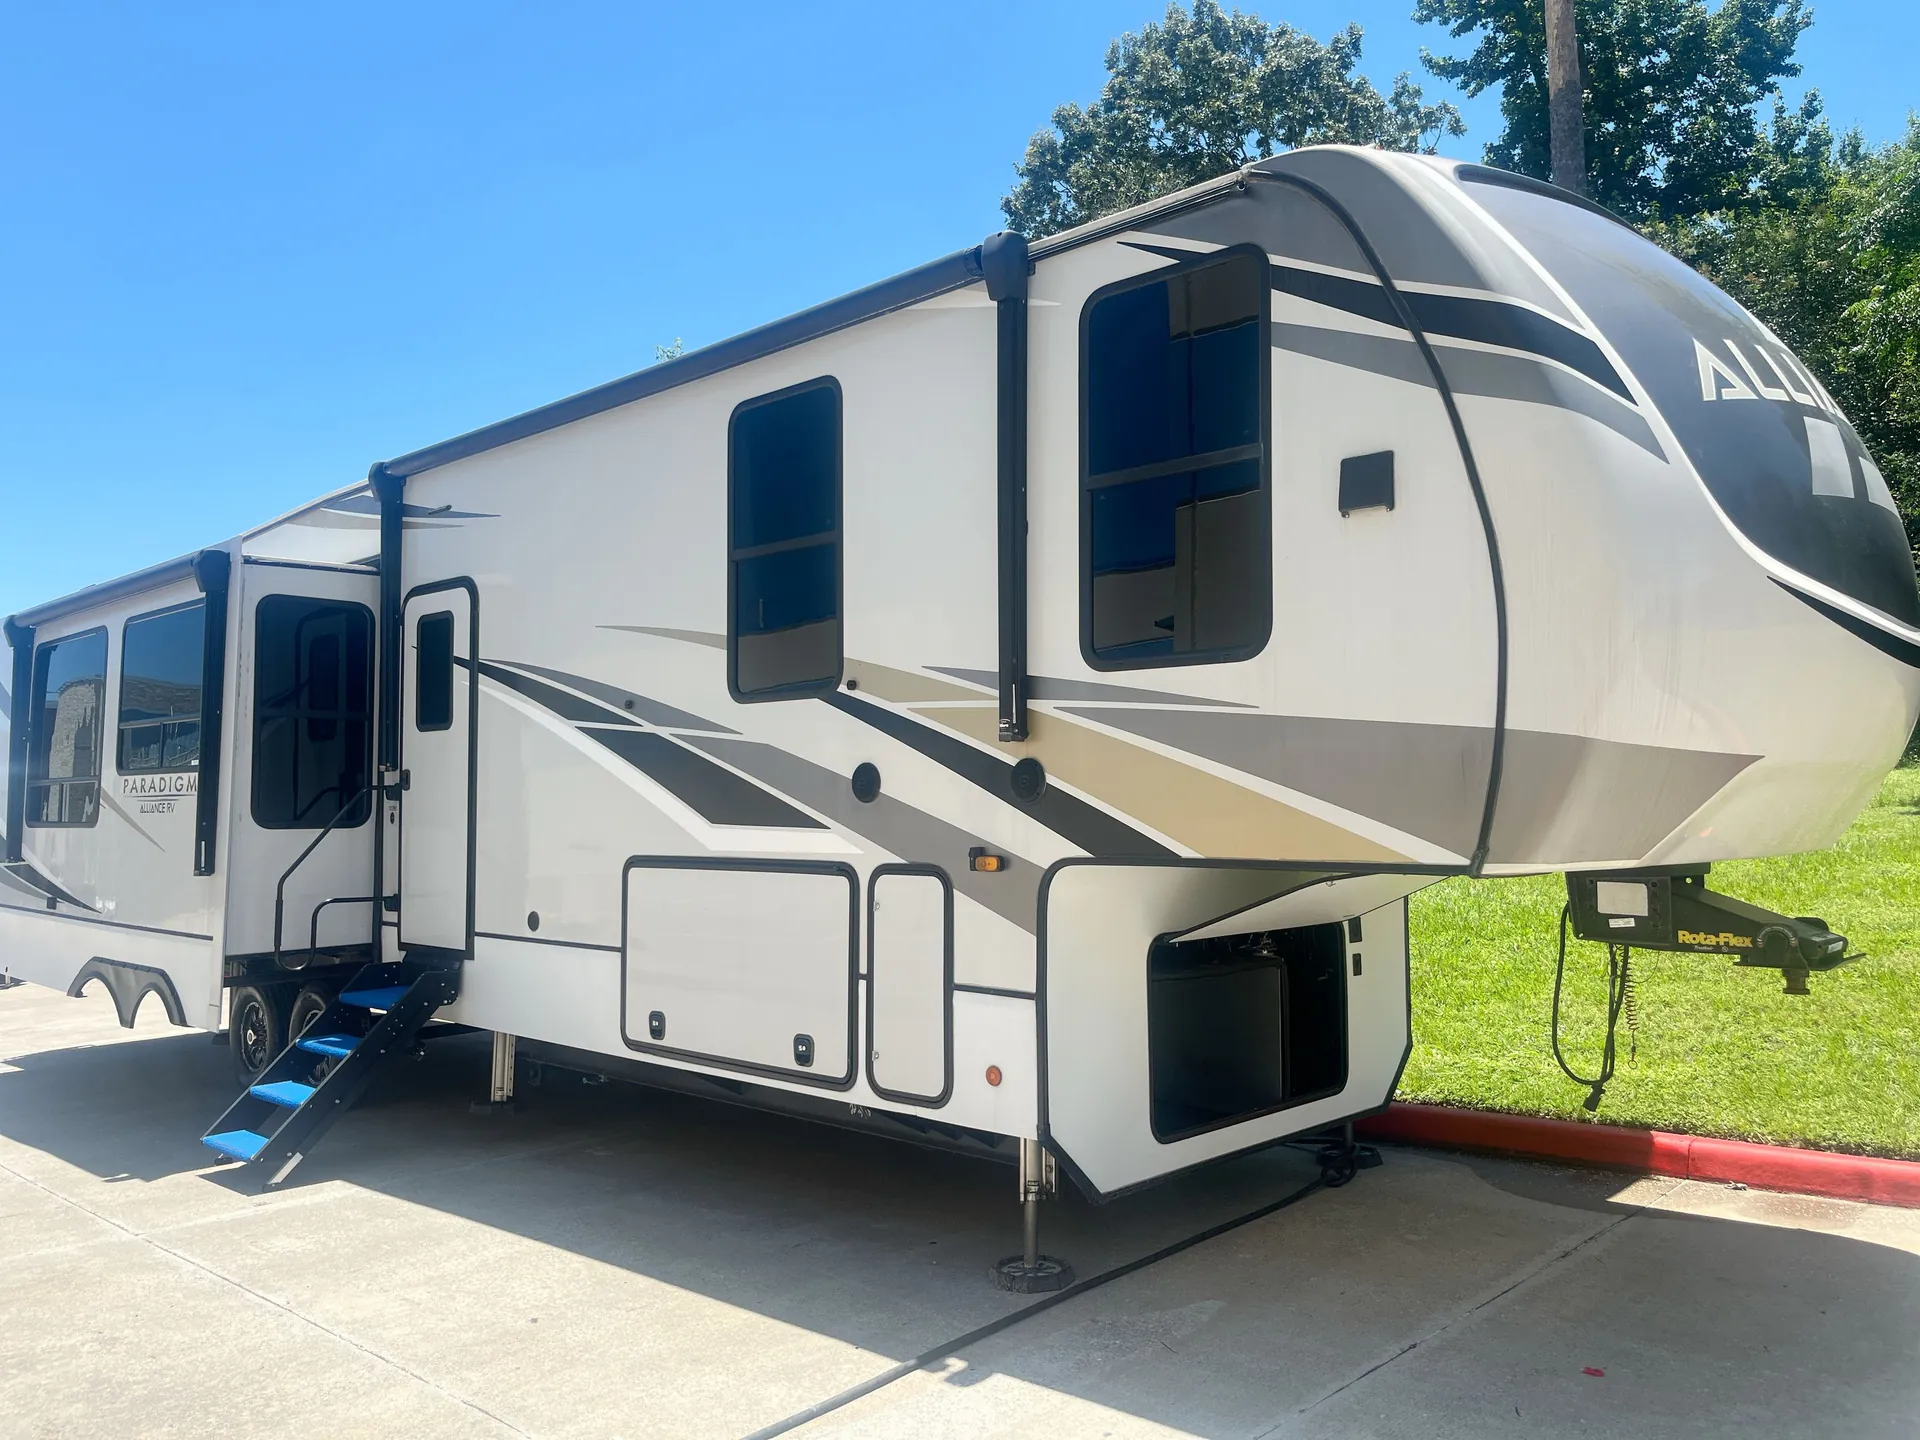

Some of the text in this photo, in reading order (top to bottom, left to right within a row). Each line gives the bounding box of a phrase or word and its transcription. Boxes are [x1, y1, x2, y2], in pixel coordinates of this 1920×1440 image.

[123, 775, 197, 793] PARADIGM
[140, 803, 175, 813] ALLIANCE RV
[1678, 930, 1753, 947] Rota-Flex
